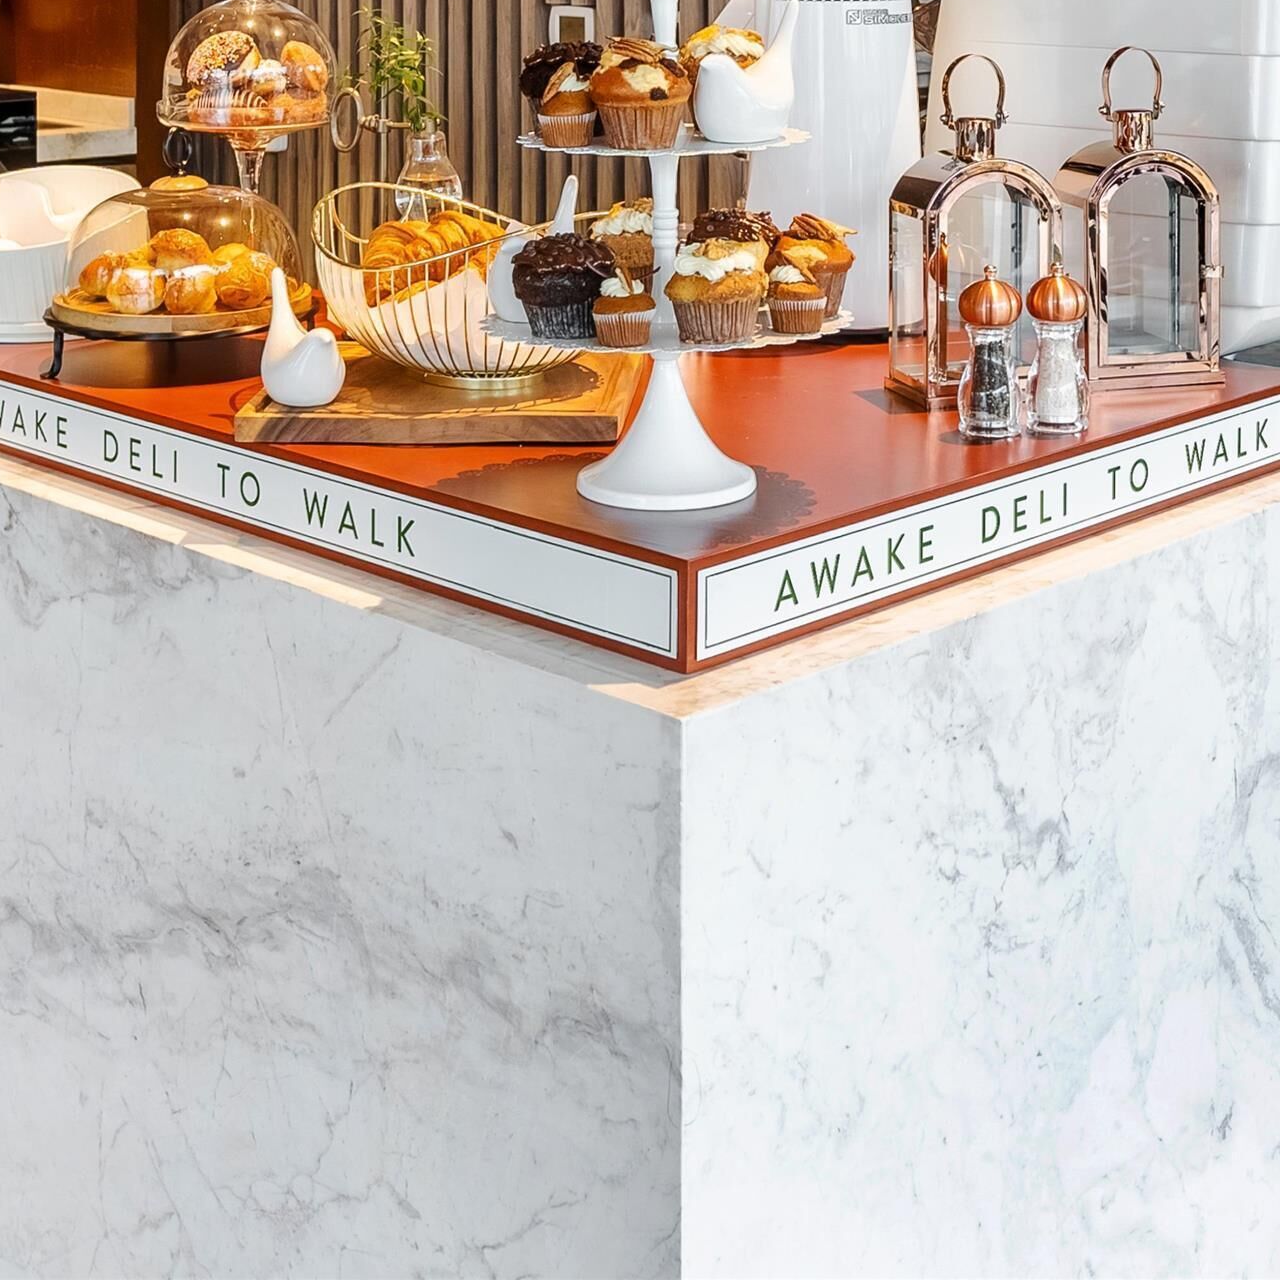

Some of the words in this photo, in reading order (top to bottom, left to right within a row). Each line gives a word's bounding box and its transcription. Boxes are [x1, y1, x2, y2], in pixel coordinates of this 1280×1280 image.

[103, 429, 178, 484] DELI
[216, 462, 261, 507] TO
[303, 487, 416, 558] WALK
[774, 524, 935, 612] AWAKE
[981, 482, 1068, 544] DELI
[1107, 457, 1150, 501] TO
[1185, 417, 1270, 475] WALK
